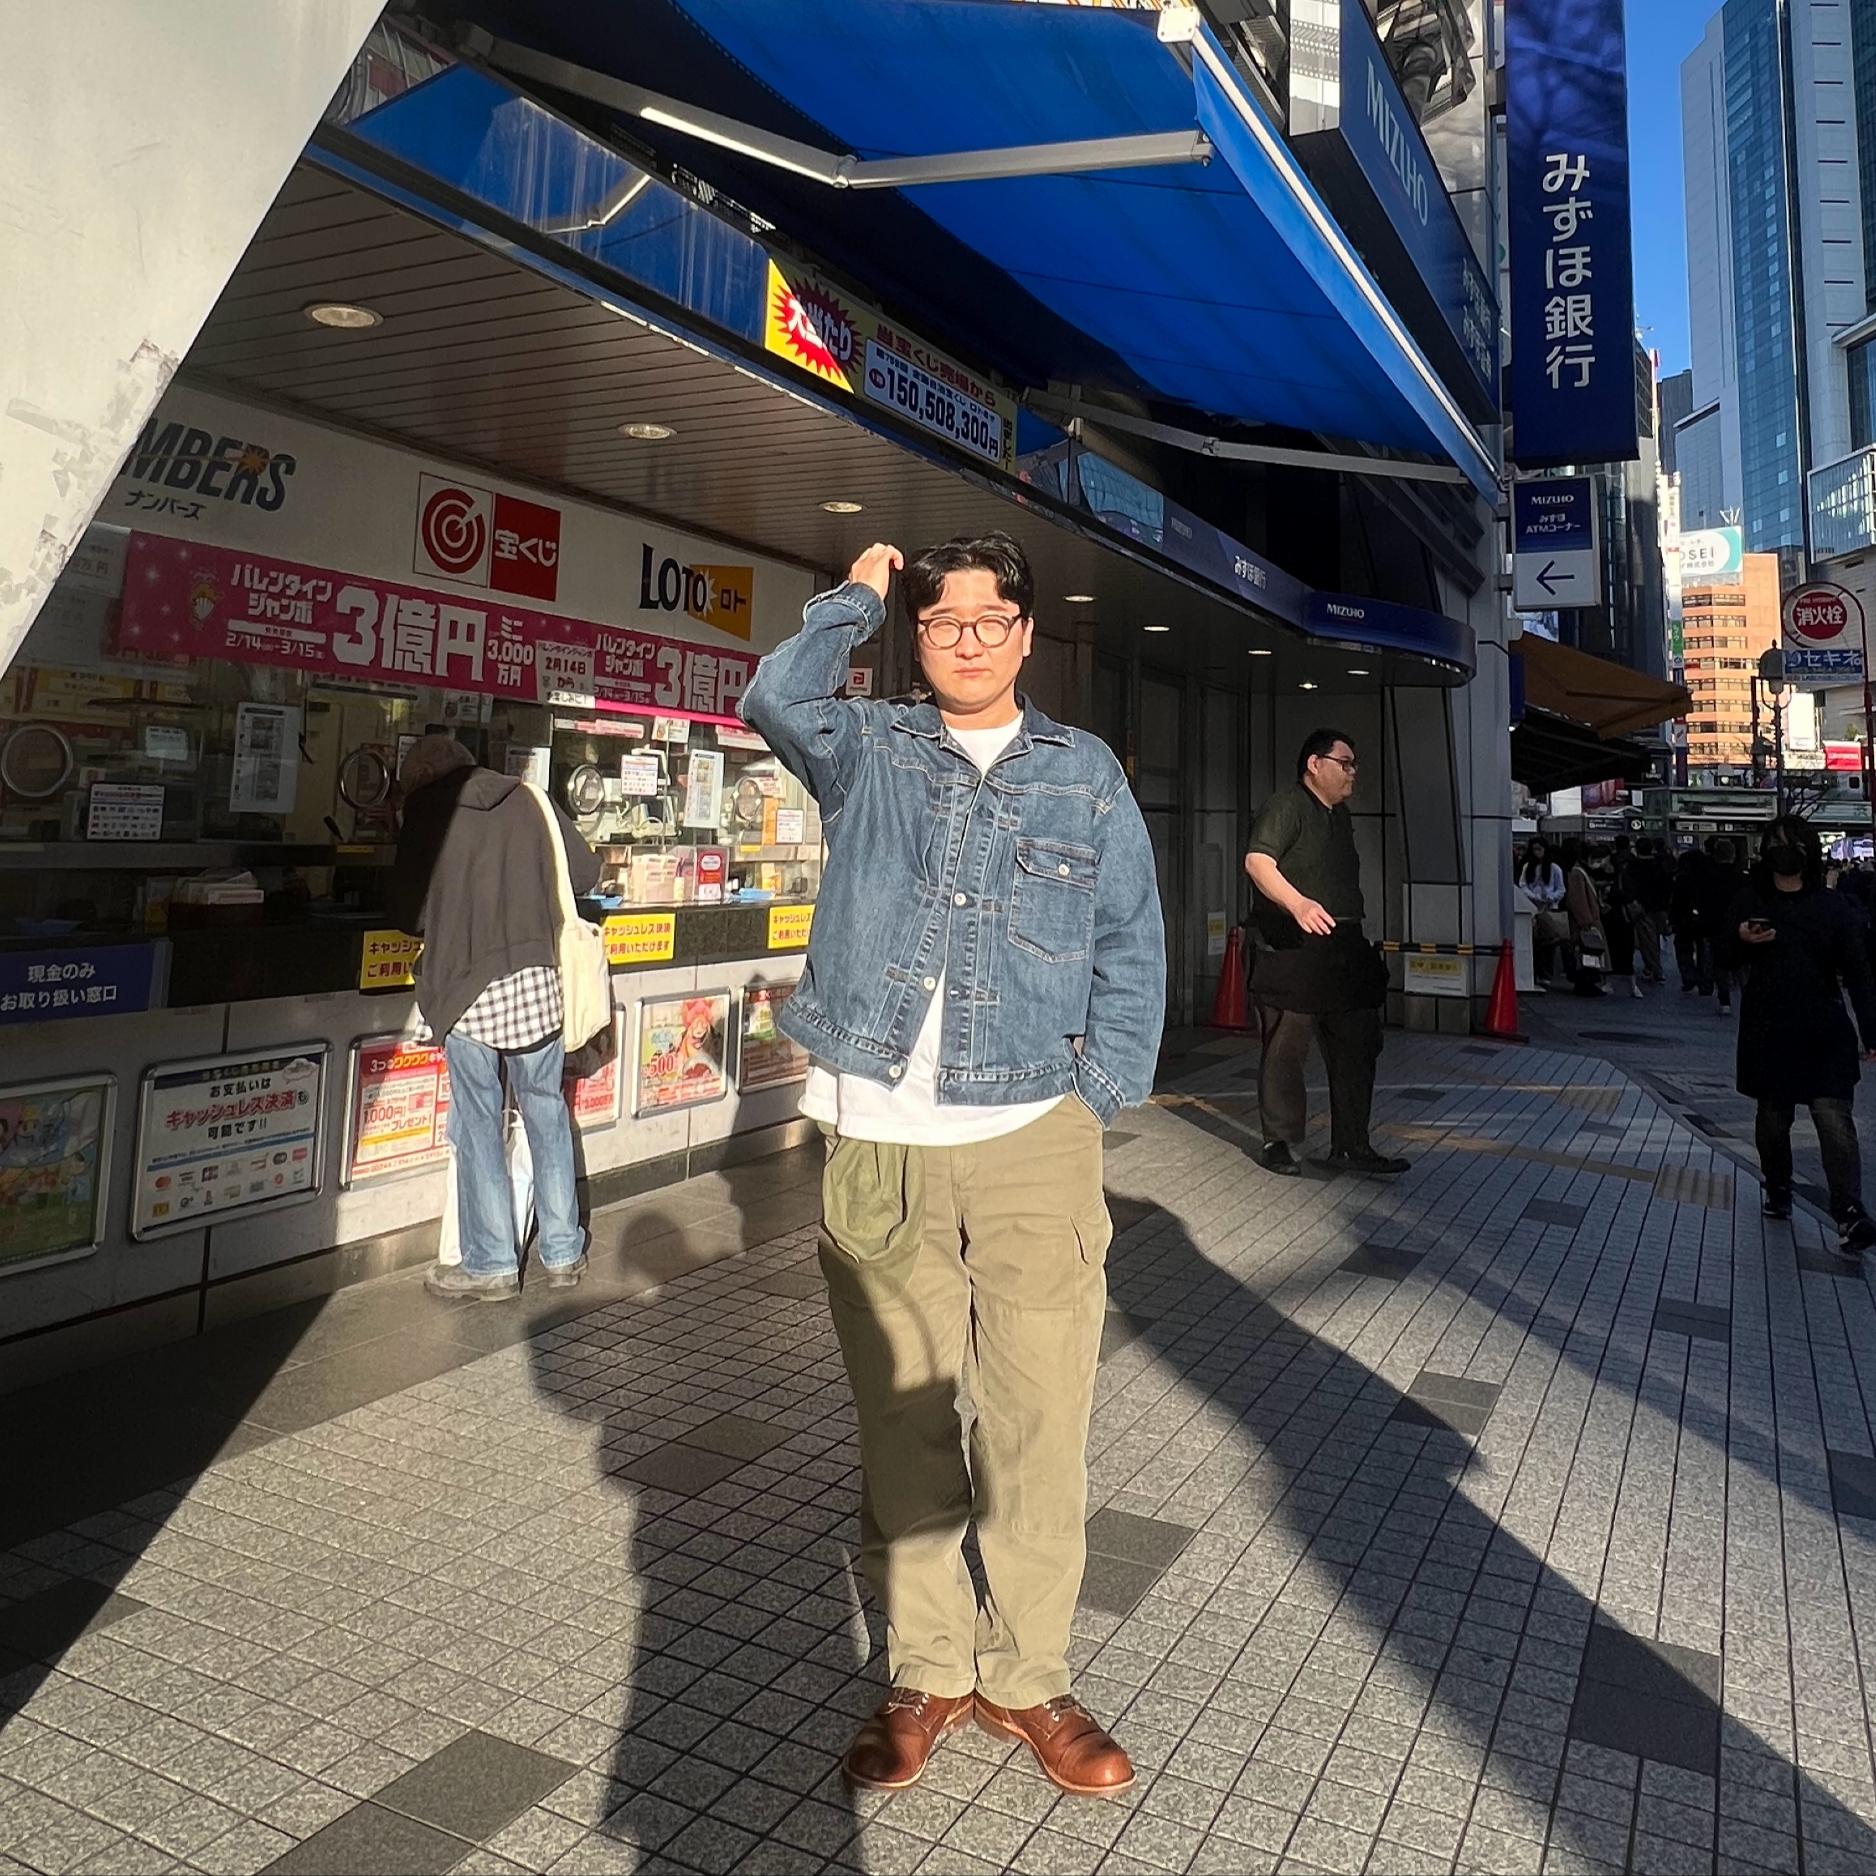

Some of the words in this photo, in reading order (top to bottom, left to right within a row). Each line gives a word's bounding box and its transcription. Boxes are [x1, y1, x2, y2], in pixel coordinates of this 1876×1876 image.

[1366, 56, 1429, 227] MIZUHO
[1541, 152, 1597, 391] みずほ銀行
[787, 294, 852, 361] 大当たり
[1530, 494, 1575, 506] MIZUHO
[1524, 523, 1582, 534] ATMコーナー
[494, 528, 557, 567] 宝くじ
[230, 563, 333, 602] バレンタイン
[638, 542, 708, 614] LOTO
[1233, 555, 1267, 590] みずほ銀行
[247, 592, 315, 625] ジャンボ
[1326, 603, 1365, 619] MIZUHO
[1796, 604, 1845, 627] 消火栓
[331, 584, 489, 683] 3億円
[595, 632, 656, 660] バレンタイン
[497, 663, 523, 688] 万円
[545, 657, 586, 675] 2月14日
[604, 654, 645, 678] ジャンボ
[654, 647, 749, 714] 3億円
[604, 922, 671, 937] キャッシュレス決済
[773, 912, 811, 925] キャッシュレス
[27, 962, 96, 983] 現金のみ
[0, 985, 118, 1012] お取り扱い窓口
[209, 1077, 272, 1098] お支払いは
